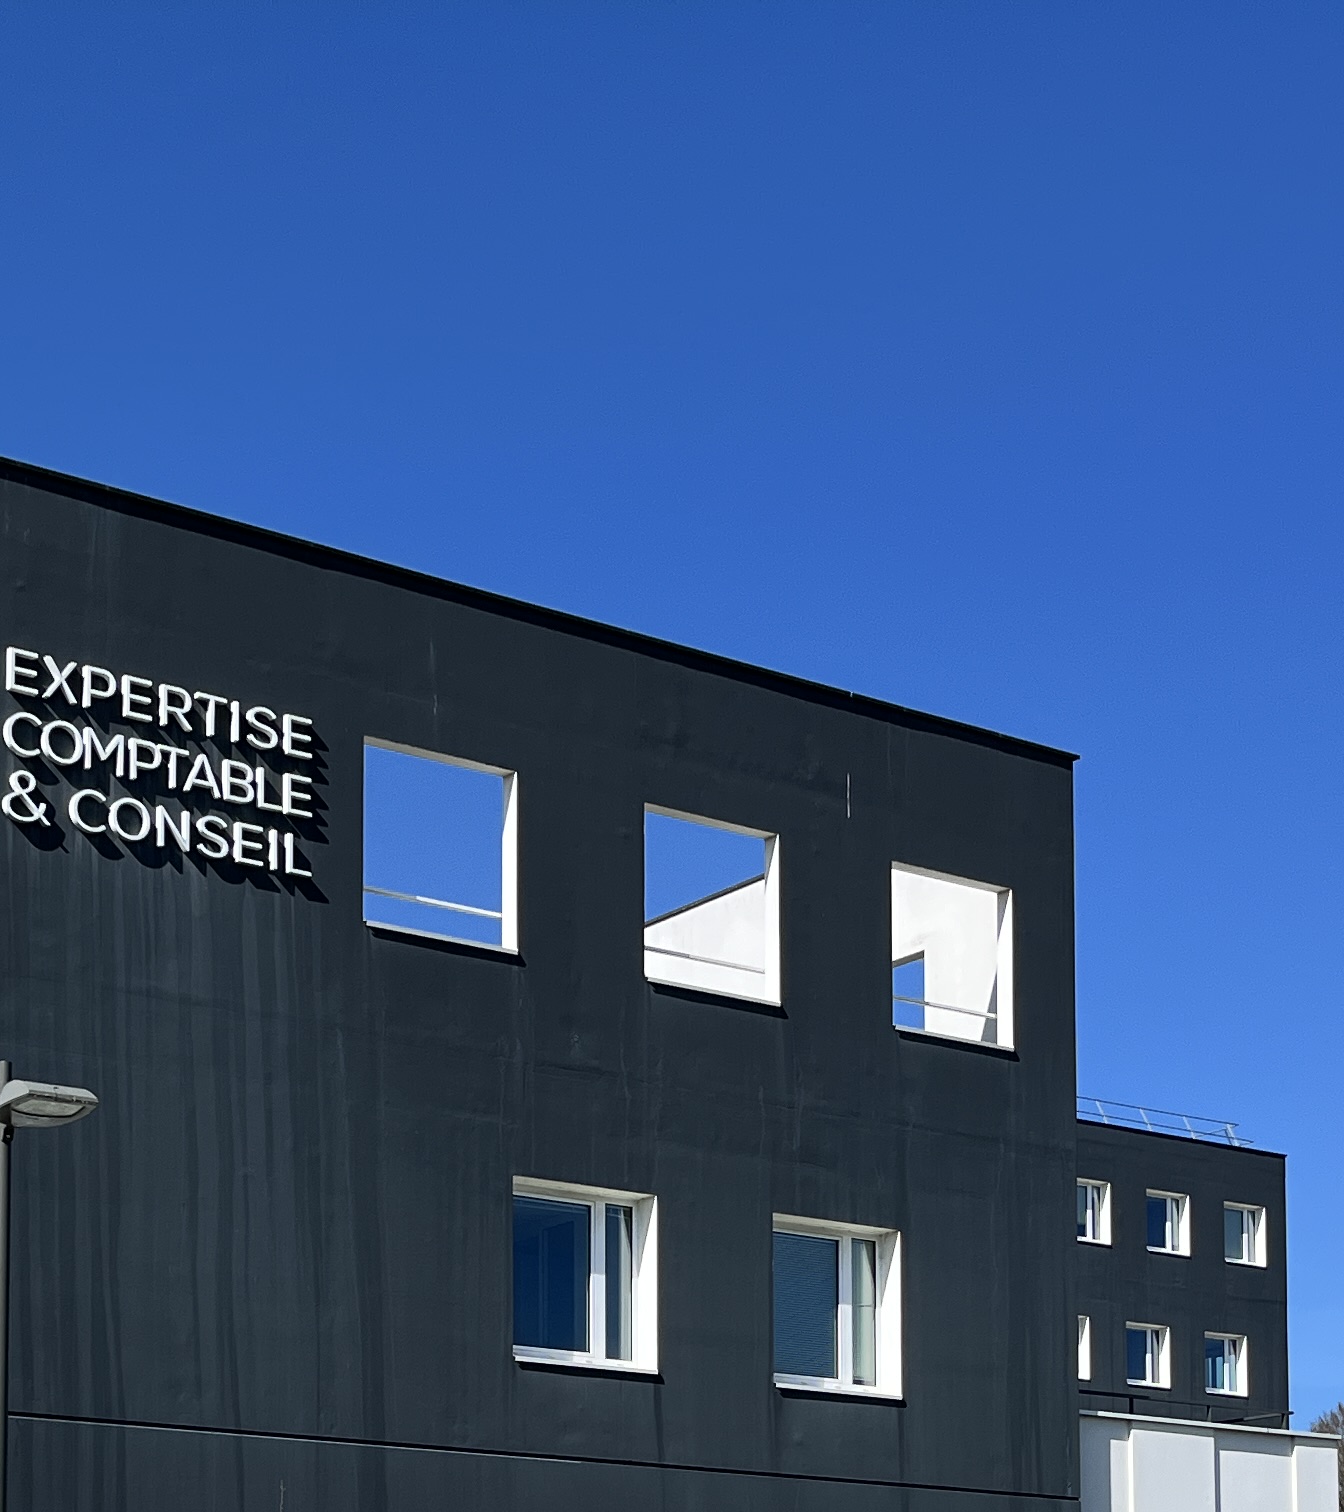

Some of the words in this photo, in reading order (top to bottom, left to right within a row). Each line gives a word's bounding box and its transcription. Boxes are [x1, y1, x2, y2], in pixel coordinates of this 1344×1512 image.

[5, 645, 313, 759] EXPERTISE
[2, 711, 313, 818] COMPTABLE
[1, 769, 51, 827] &
[68, 788, 313, 877] CONSEIL
